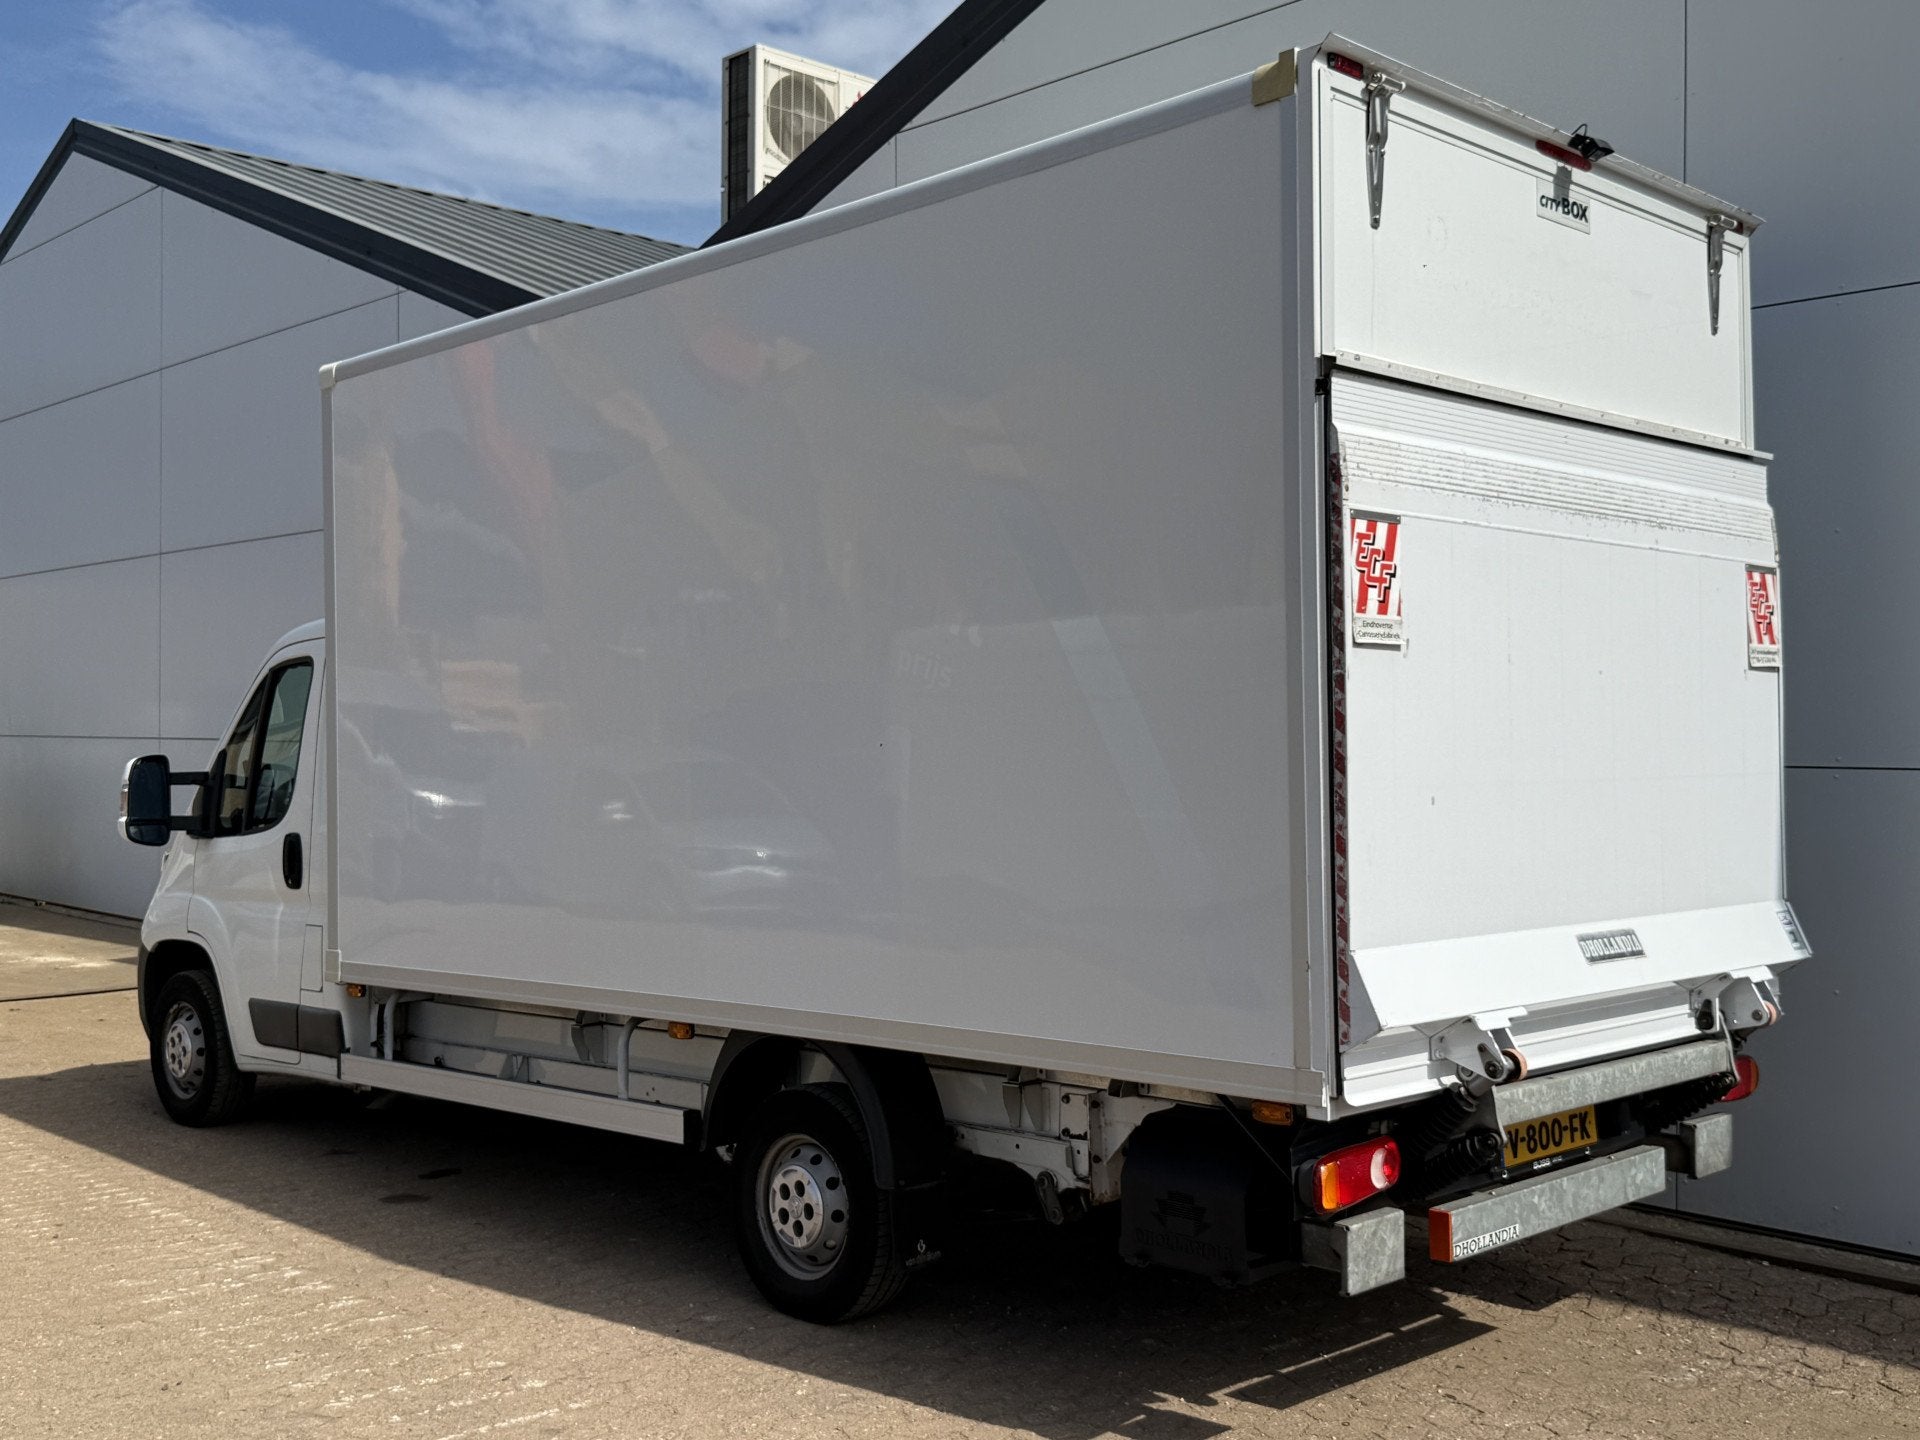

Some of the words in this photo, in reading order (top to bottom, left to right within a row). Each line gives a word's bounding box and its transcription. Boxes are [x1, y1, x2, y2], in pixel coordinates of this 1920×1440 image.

[1579, 934, 1642, 958] DHOLLANDIA
[1508, 1111, 1591, 1159] V-800-FK
[1454, 1225, 1519, 1258] DHOLLANDIA
